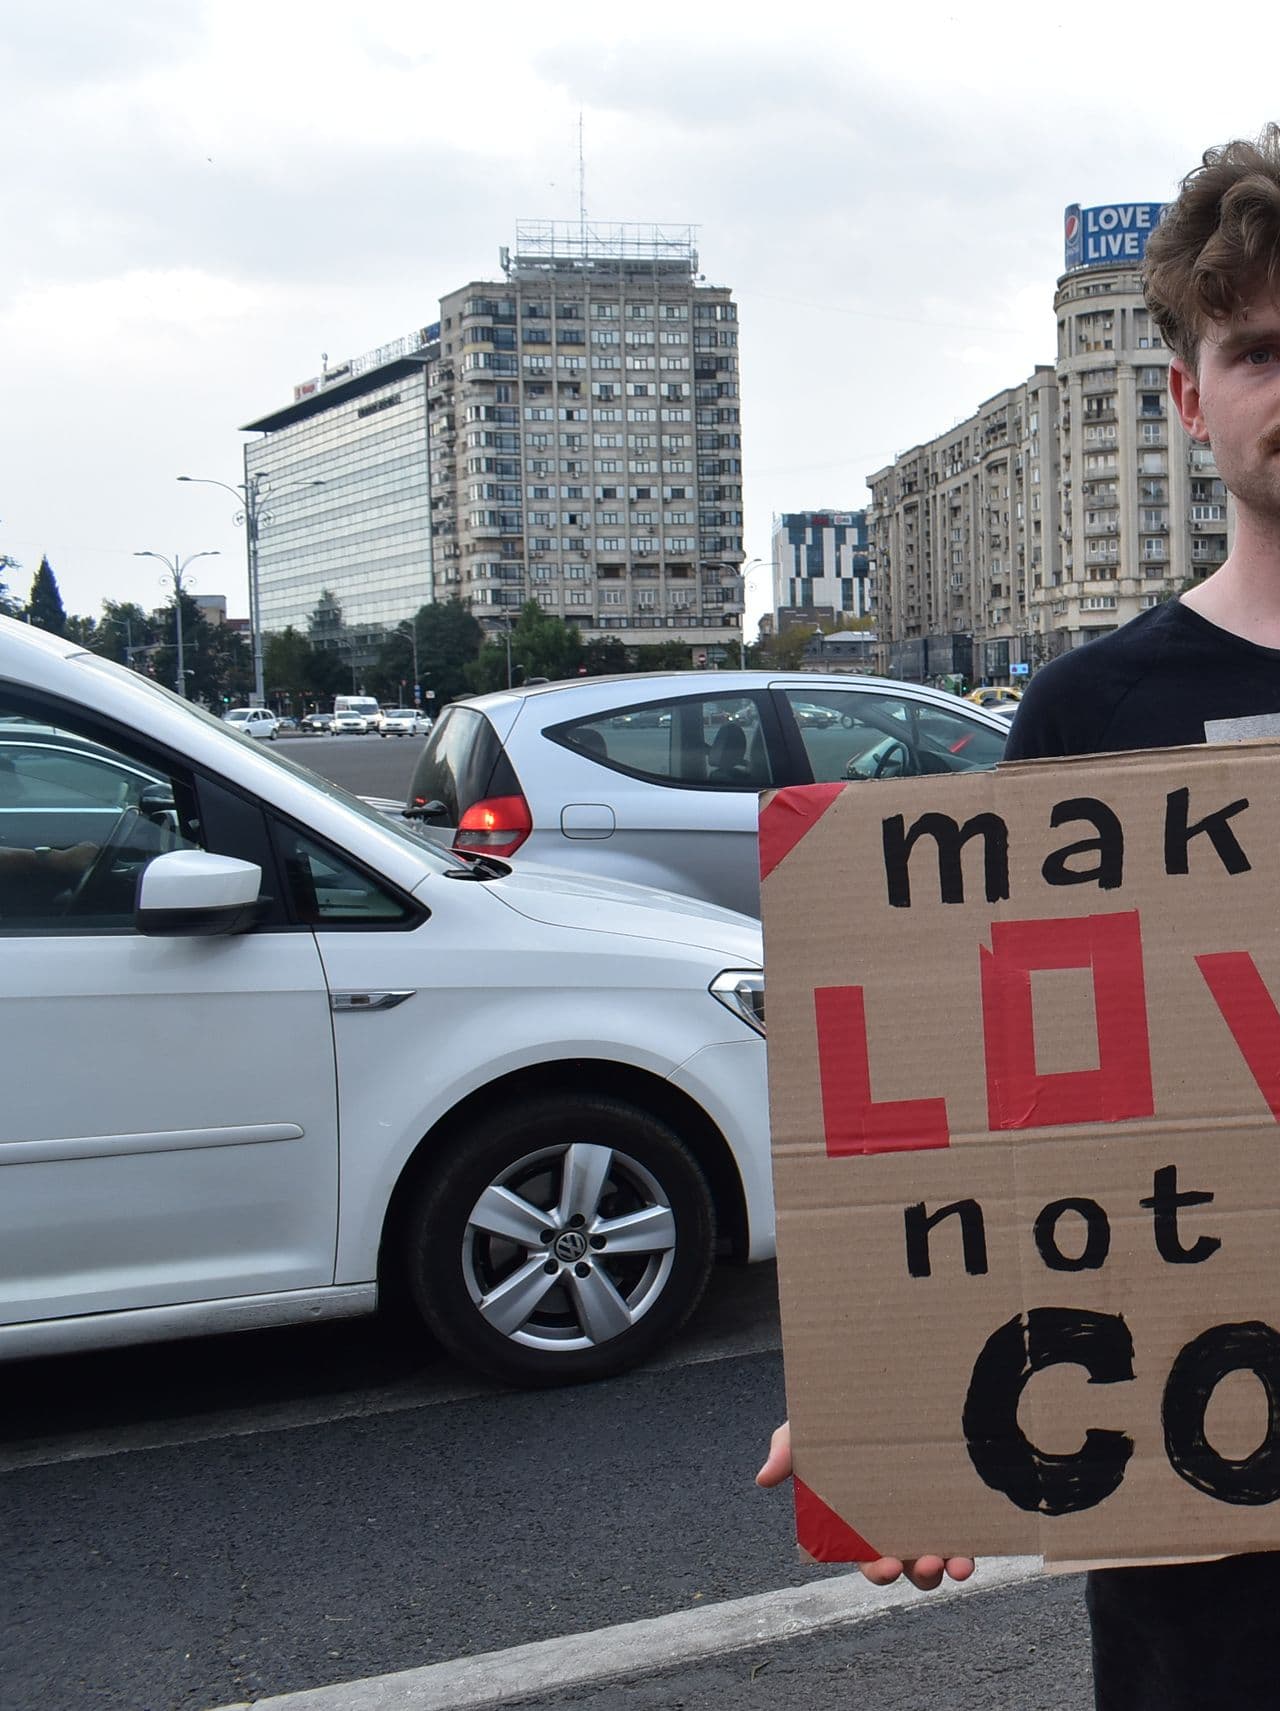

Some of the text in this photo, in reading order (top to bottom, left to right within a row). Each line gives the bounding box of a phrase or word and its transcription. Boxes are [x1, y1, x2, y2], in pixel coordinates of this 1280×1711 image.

[1087, 205, 1150, 233] LOVE
[1087, 232, 1140, 260] LIVE
[903, 1163, 1222, 1279] not
